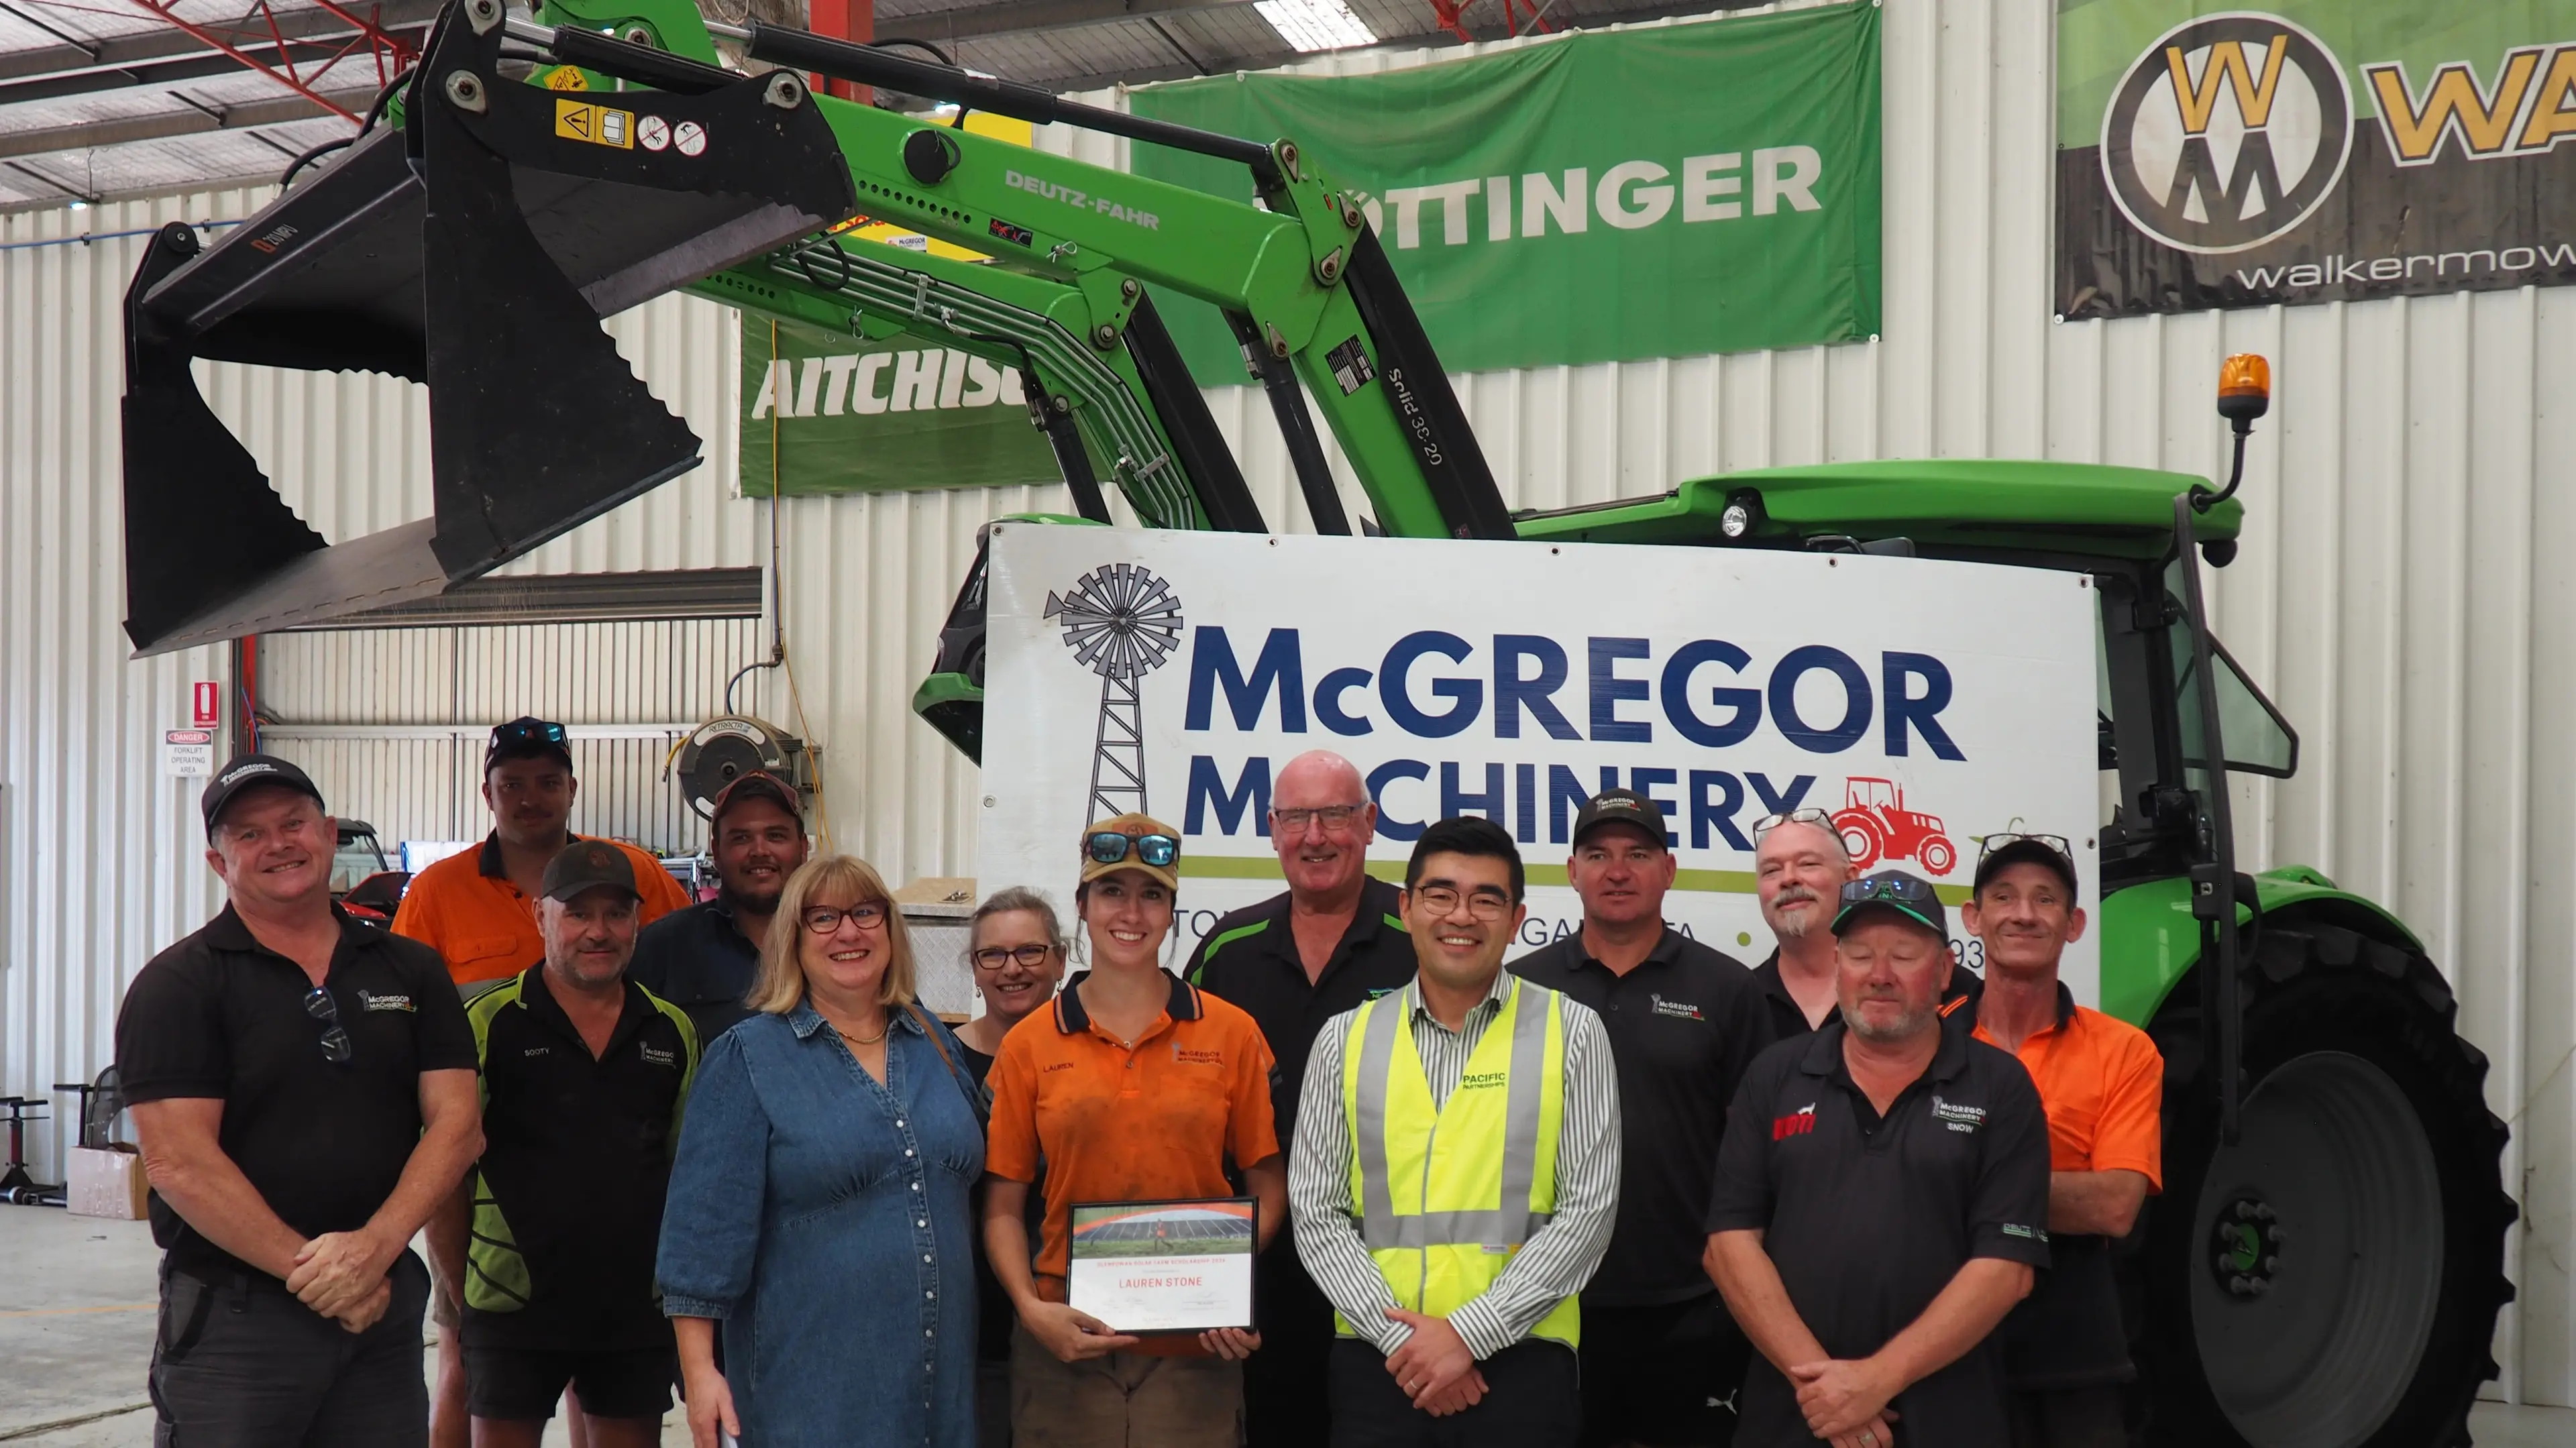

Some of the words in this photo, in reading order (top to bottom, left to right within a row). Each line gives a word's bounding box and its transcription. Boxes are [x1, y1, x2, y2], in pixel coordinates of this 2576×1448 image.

[1005, 169, 1159, 231] DEUTZ-FAHR
[1252, 144, 1823, 249] TTINGER
[751, 347, 1027, 420] AITCHIS
[1388, 368, 1419, 415] Solid
[1183, 624, 1969, 763] McGREGOR
[174, 734, 203, 742] DANGER
[1183, 755, 1817, 853] MCHINERY
[368, 995, 410, 1003] McGREGOR
[1658, 1000, 1698, 1011] McGREGOR
[1658, 1007, 1693, 1016] MACHINERY
[524, 1048, 550, 1057] SOOTY
[645, 1048, 674, 1058] McGREGO
[1043, 1062, 1074, 1073] LAUREN
[1462, 1072, 1506, 1084] PACIFIC
[1462, 1082, 1505, 1090] PARTNERSHIPS
[1939, 1110, 1981, 1121] MACHINERY
[1947, 1122, 1974, 1133] SNOW
[1119, 1278, 1163, 1289] LAUREN
[1166, 1276, 1203, 1287] STONE
